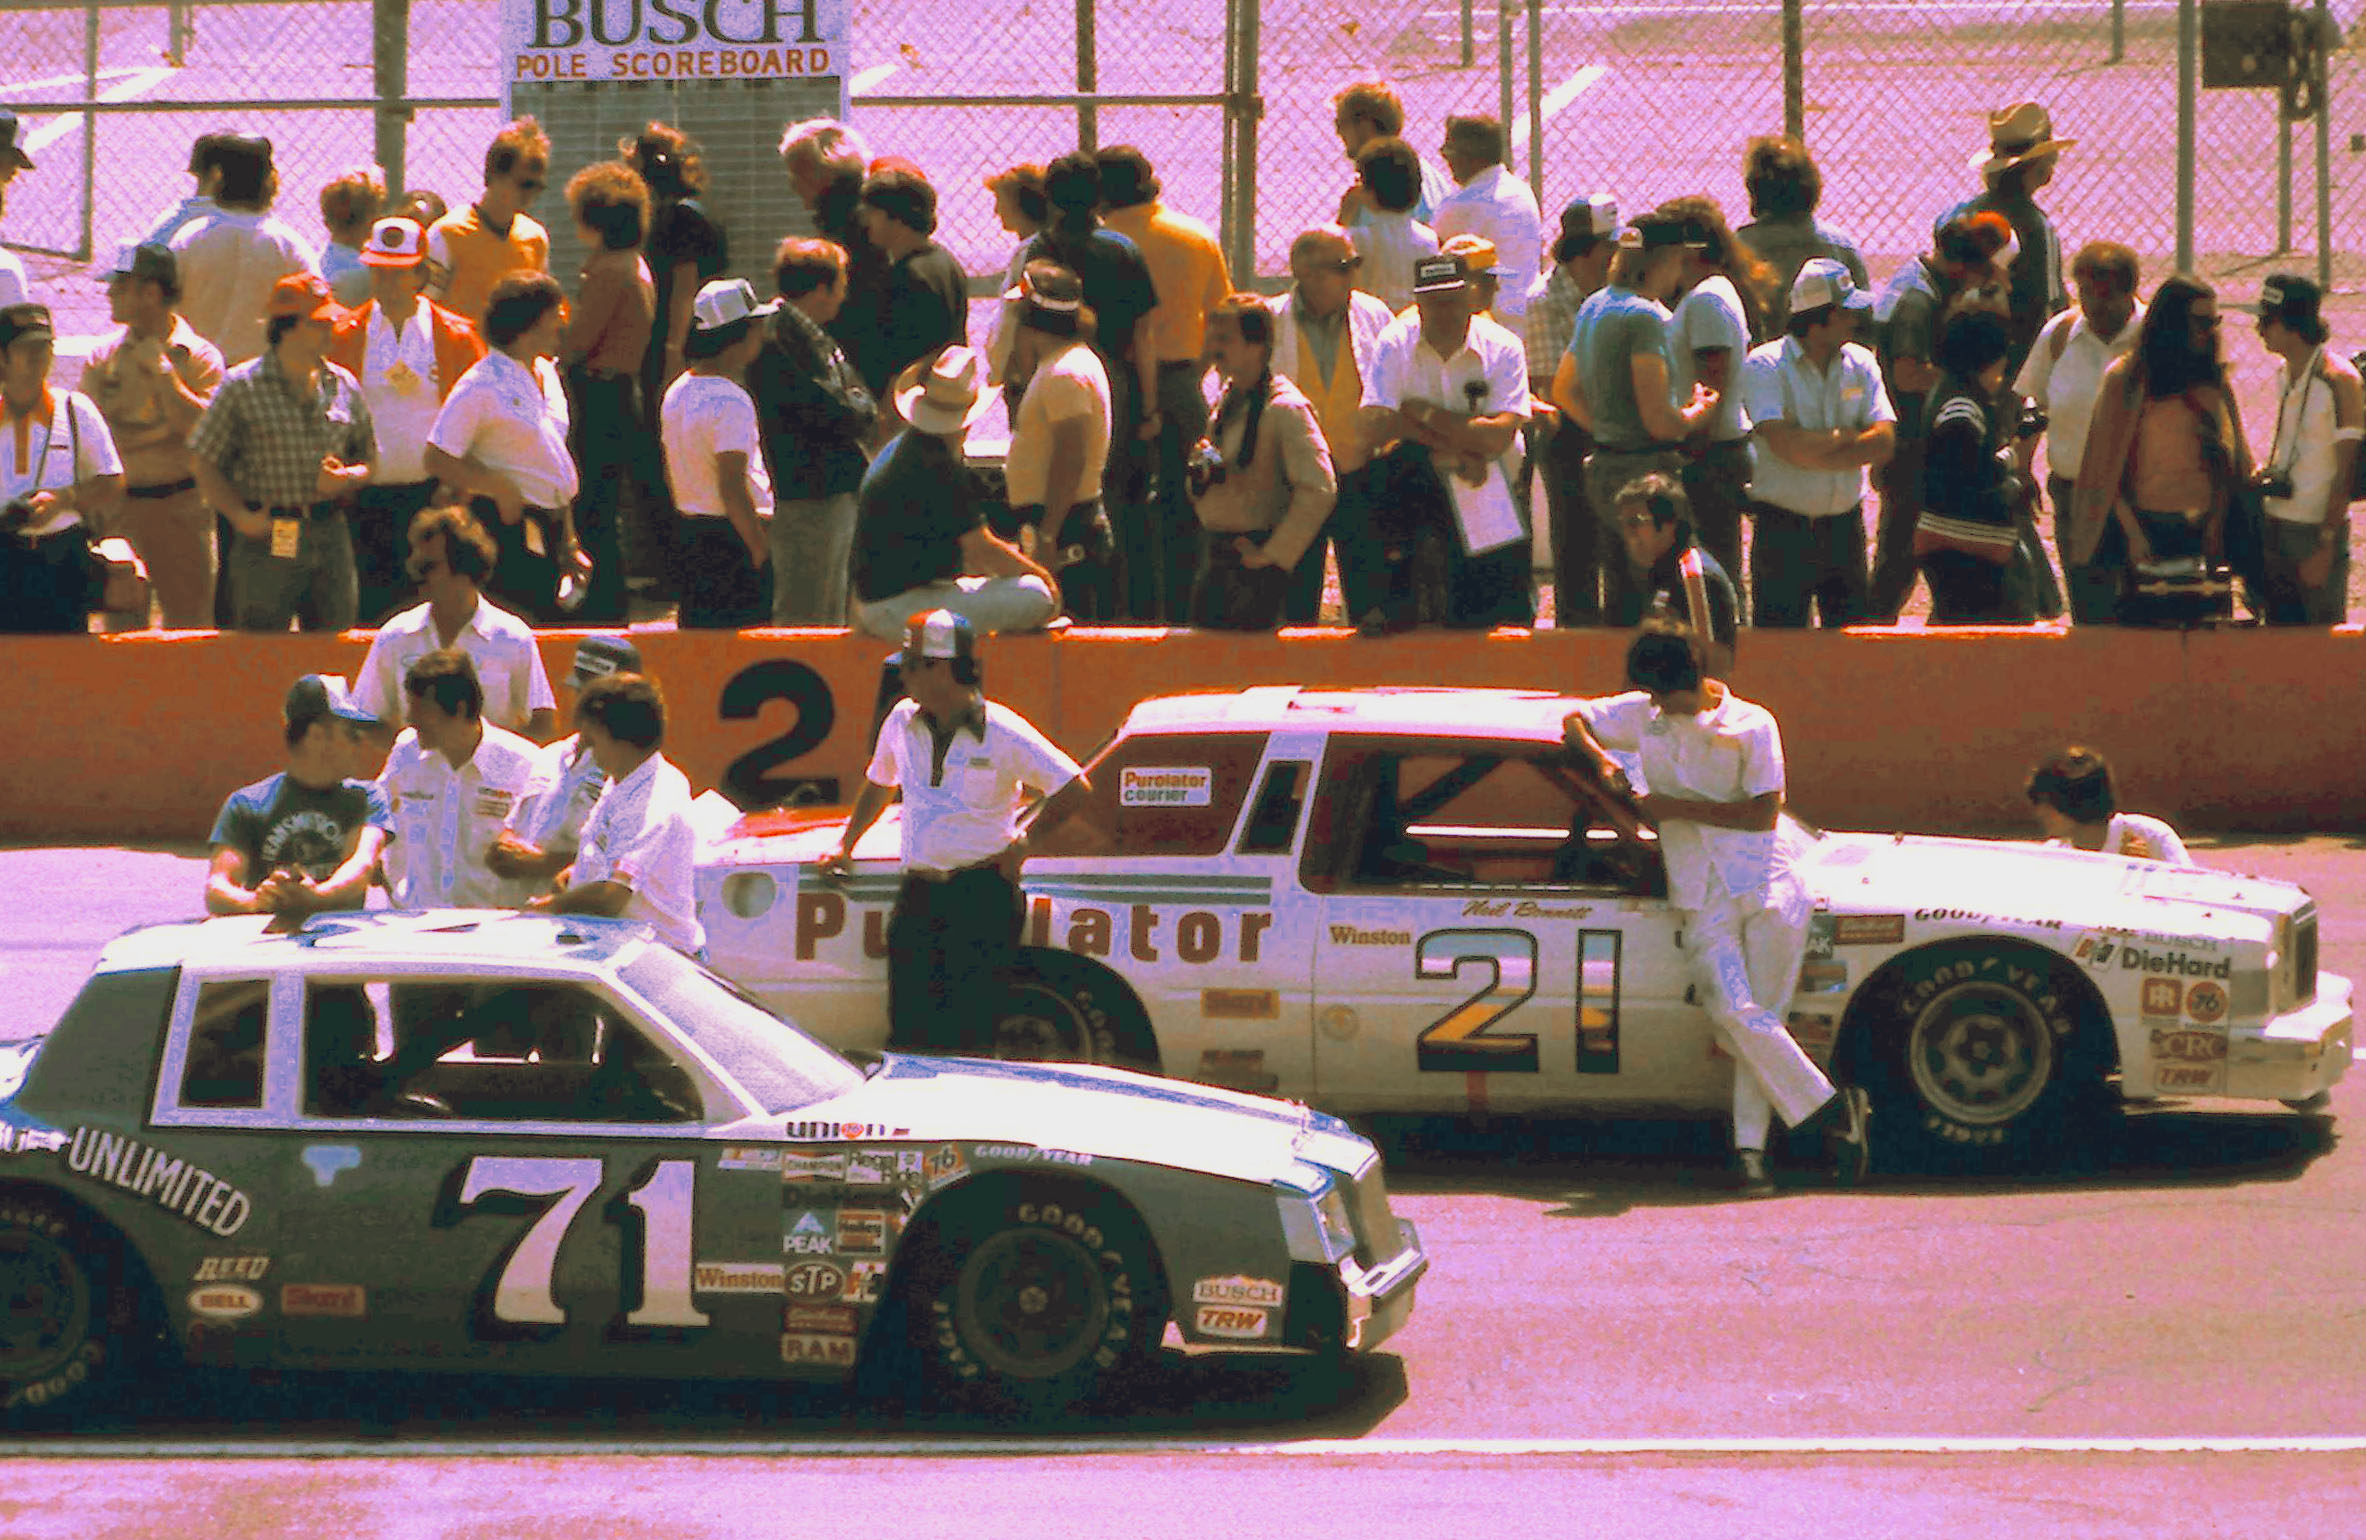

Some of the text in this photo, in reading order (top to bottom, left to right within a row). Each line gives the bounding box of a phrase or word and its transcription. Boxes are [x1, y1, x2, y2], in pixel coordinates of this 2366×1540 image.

[526, 0, 826, 48] BUSCH
[516, 48, 830, 79] POLE SCOREBOARD
[719, 658, 839, 808] 2
[1124, 771, 1207, 788] Purolator
[1124, 788, 1189, 803] courier
[796, 892, 1272, 965] Pulator
[1330, 925, 1411, 944] Winston
[2122, 947, 2231, 979] DieHard
[1416, 927, 1622, 1074] 21
[2159, 1067, 2214, 1085] TRW
[68, 1125, 251, 1237] UNLIMITED
[457, 1154, 713, 1328] 71
[782, 1235, 833, 1254] PEAK
[193, 1256, 271, 1280] REED
[696, 1267, 784, 1290] Winston
[790, 1266, 837, 1295] STP
[201, 1294, 251, 1309] BELL
[1200, 1284, 1277, 1301] BUSCH
[1203, 1309, 1263, 1329] TRW
[786, 1339, 850, 1359] RAM
